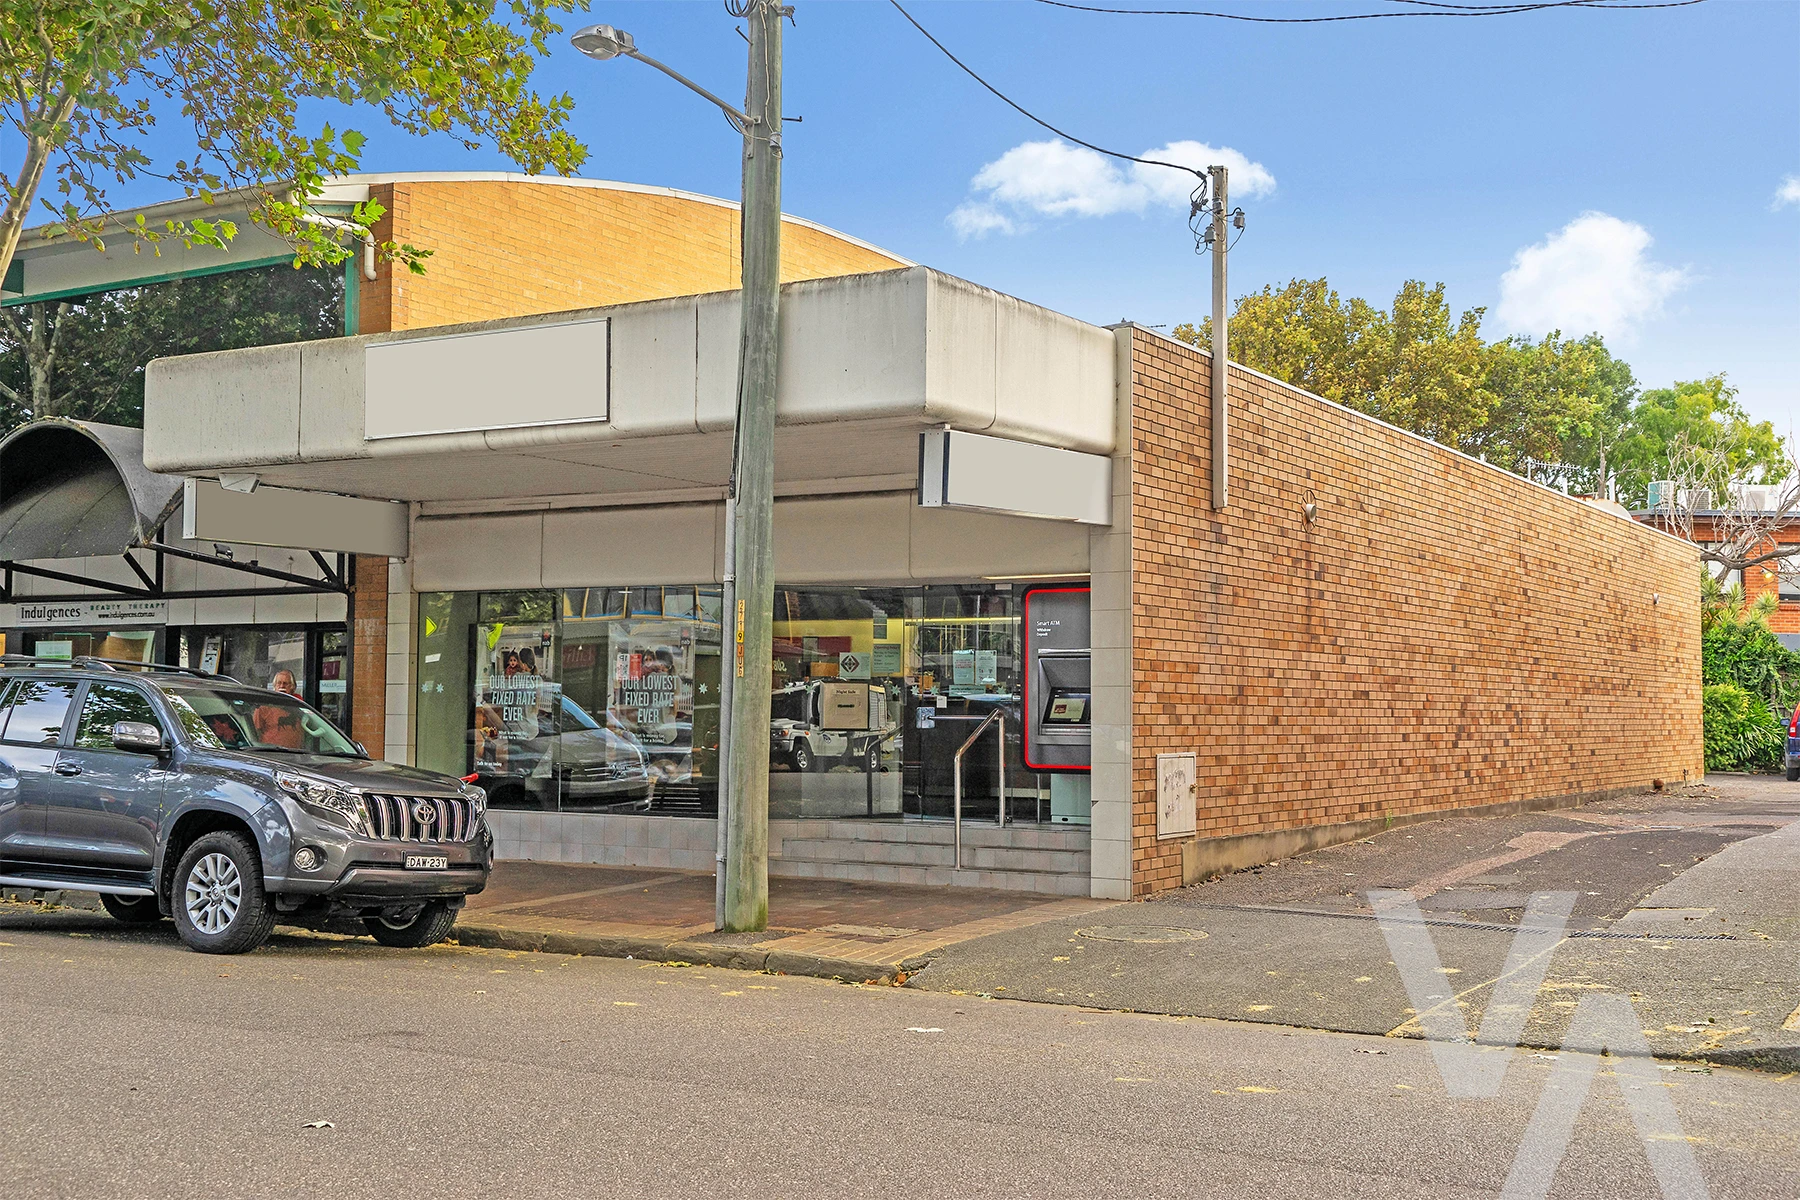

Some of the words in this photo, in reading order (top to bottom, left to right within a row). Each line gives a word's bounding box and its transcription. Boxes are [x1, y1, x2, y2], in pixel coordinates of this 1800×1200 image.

[21, 606, 81, 621] Indulgences
[489, 675, 505, 689] OUR
[508, 674, 540, 689] LOWEST
[621, 675, 640, 689] OUR
[642, 675, 678, 690] LOWEST
[492, 691, 514, 705] FIXED
[516, 691, 537, 705] RATE
[625, 692, 649, 706] FIXED
[652, 692, 675, 707] RATE
[503, 707, 523, 721] EVER
[637, 708, 660, 723] EVER
